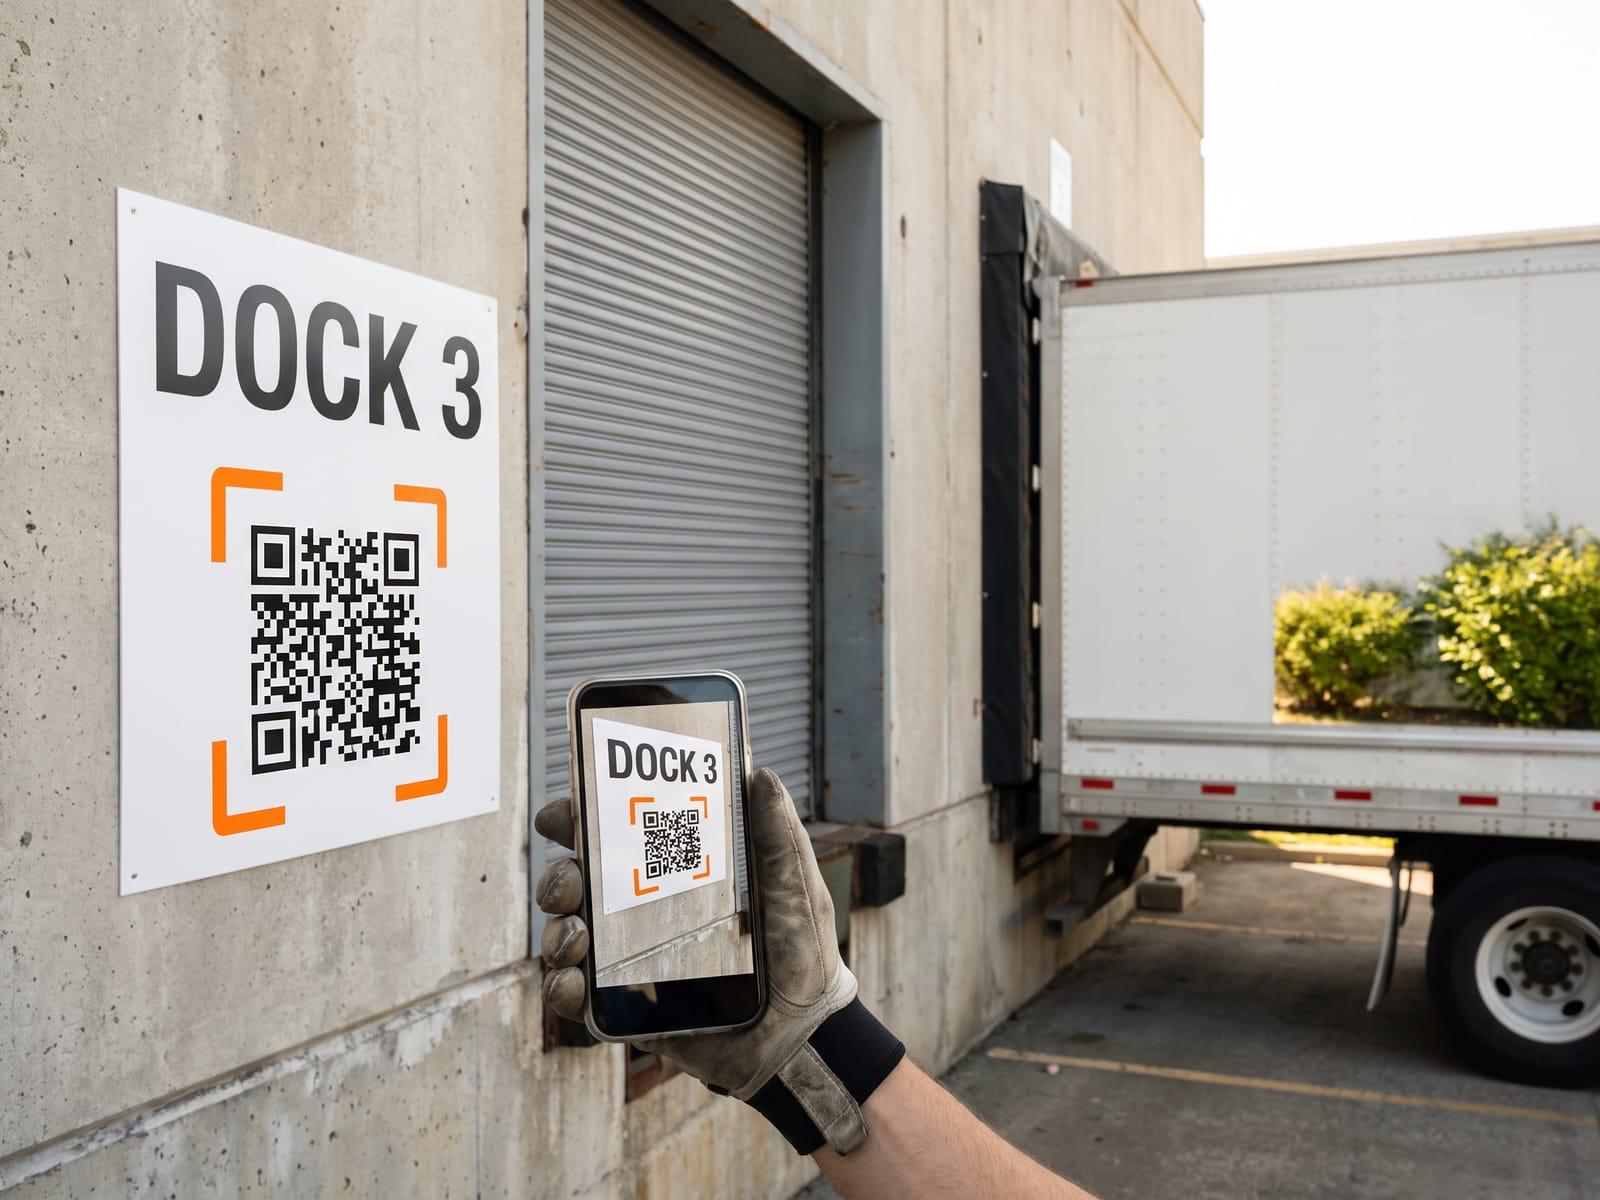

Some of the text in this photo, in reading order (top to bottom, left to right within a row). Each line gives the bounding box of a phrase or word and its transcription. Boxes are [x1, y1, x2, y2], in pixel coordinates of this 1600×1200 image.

[155, 261, 482, 440] DOCK 3
[607, 739, 718, 785] DOCK 3
